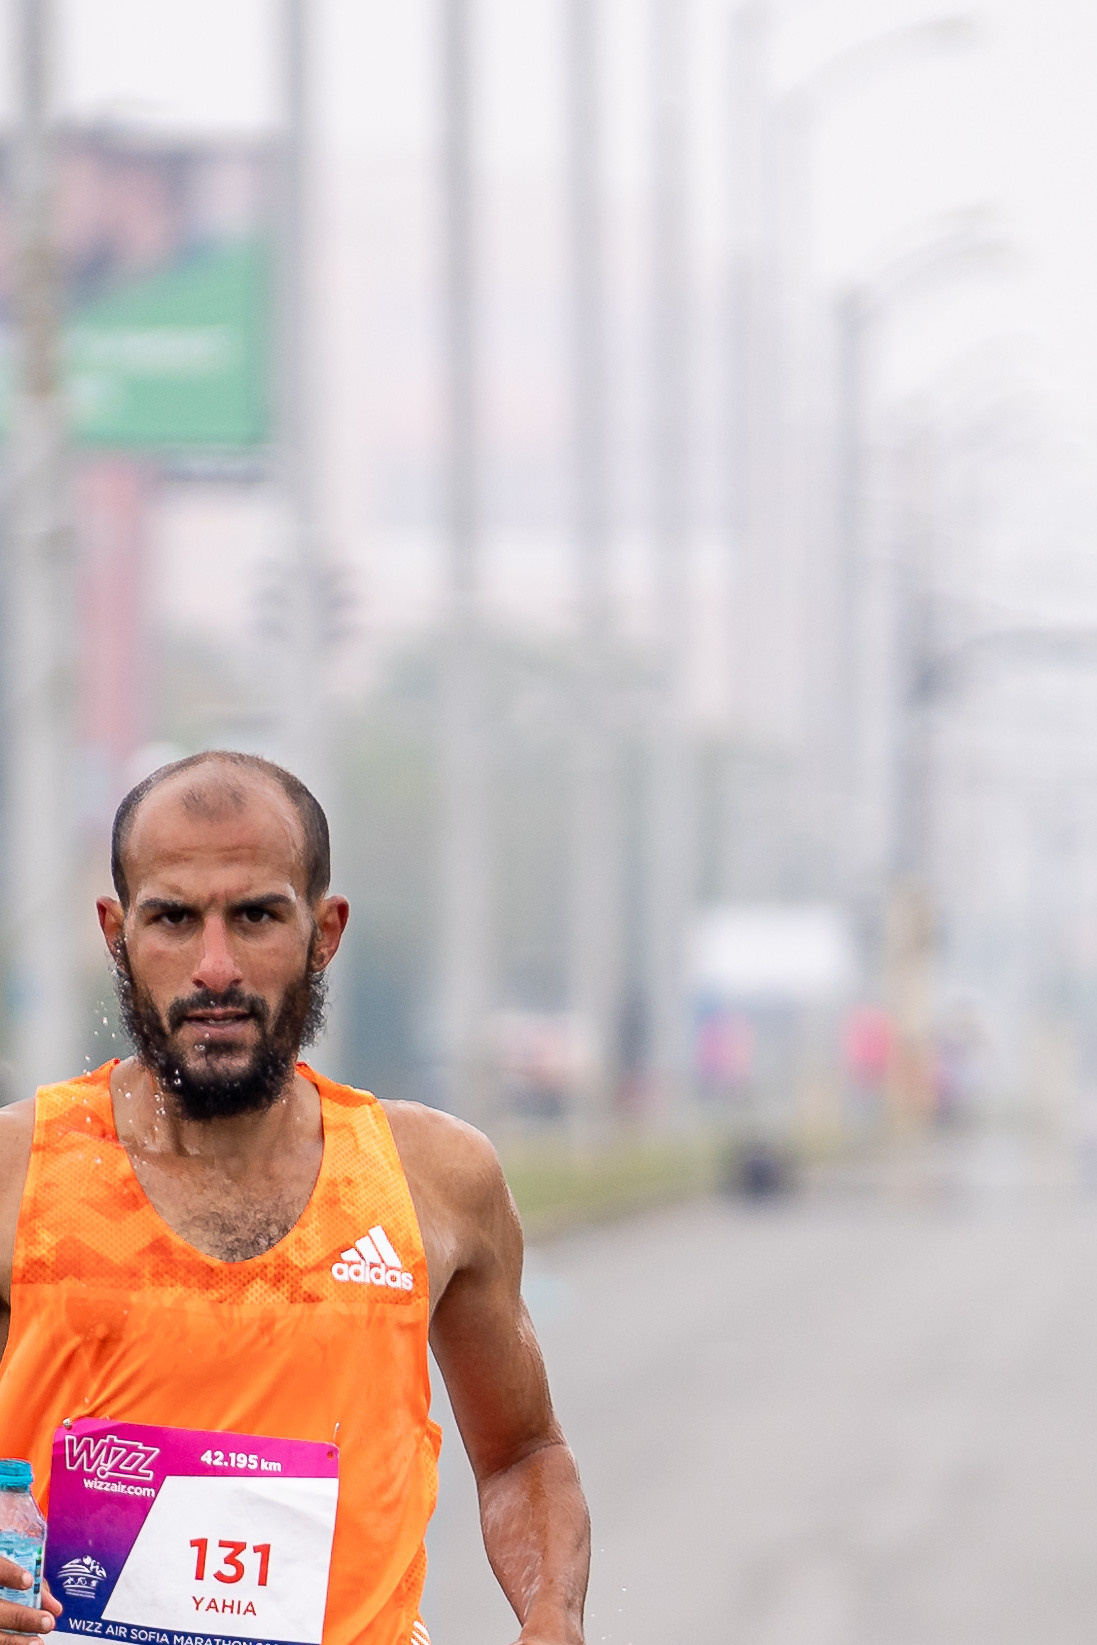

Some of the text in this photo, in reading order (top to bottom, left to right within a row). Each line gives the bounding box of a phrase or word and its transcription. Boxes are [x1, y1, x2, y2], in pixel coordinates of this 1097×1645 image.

[331, 1258, 414, 1291] adidas
[200, 1449, 282, 1473] 42.195 km
[83, 1478, 156, 1498] wizzair.com
[189, 1537, 271, 1587] 131
[192, 1595, 256, 1616] YAHIA
[68, 1617, 102, 1634] WIZZ
[105, 1624, 127, 1638] AIR
[129, 1628, 169, 1644] SOFIA
